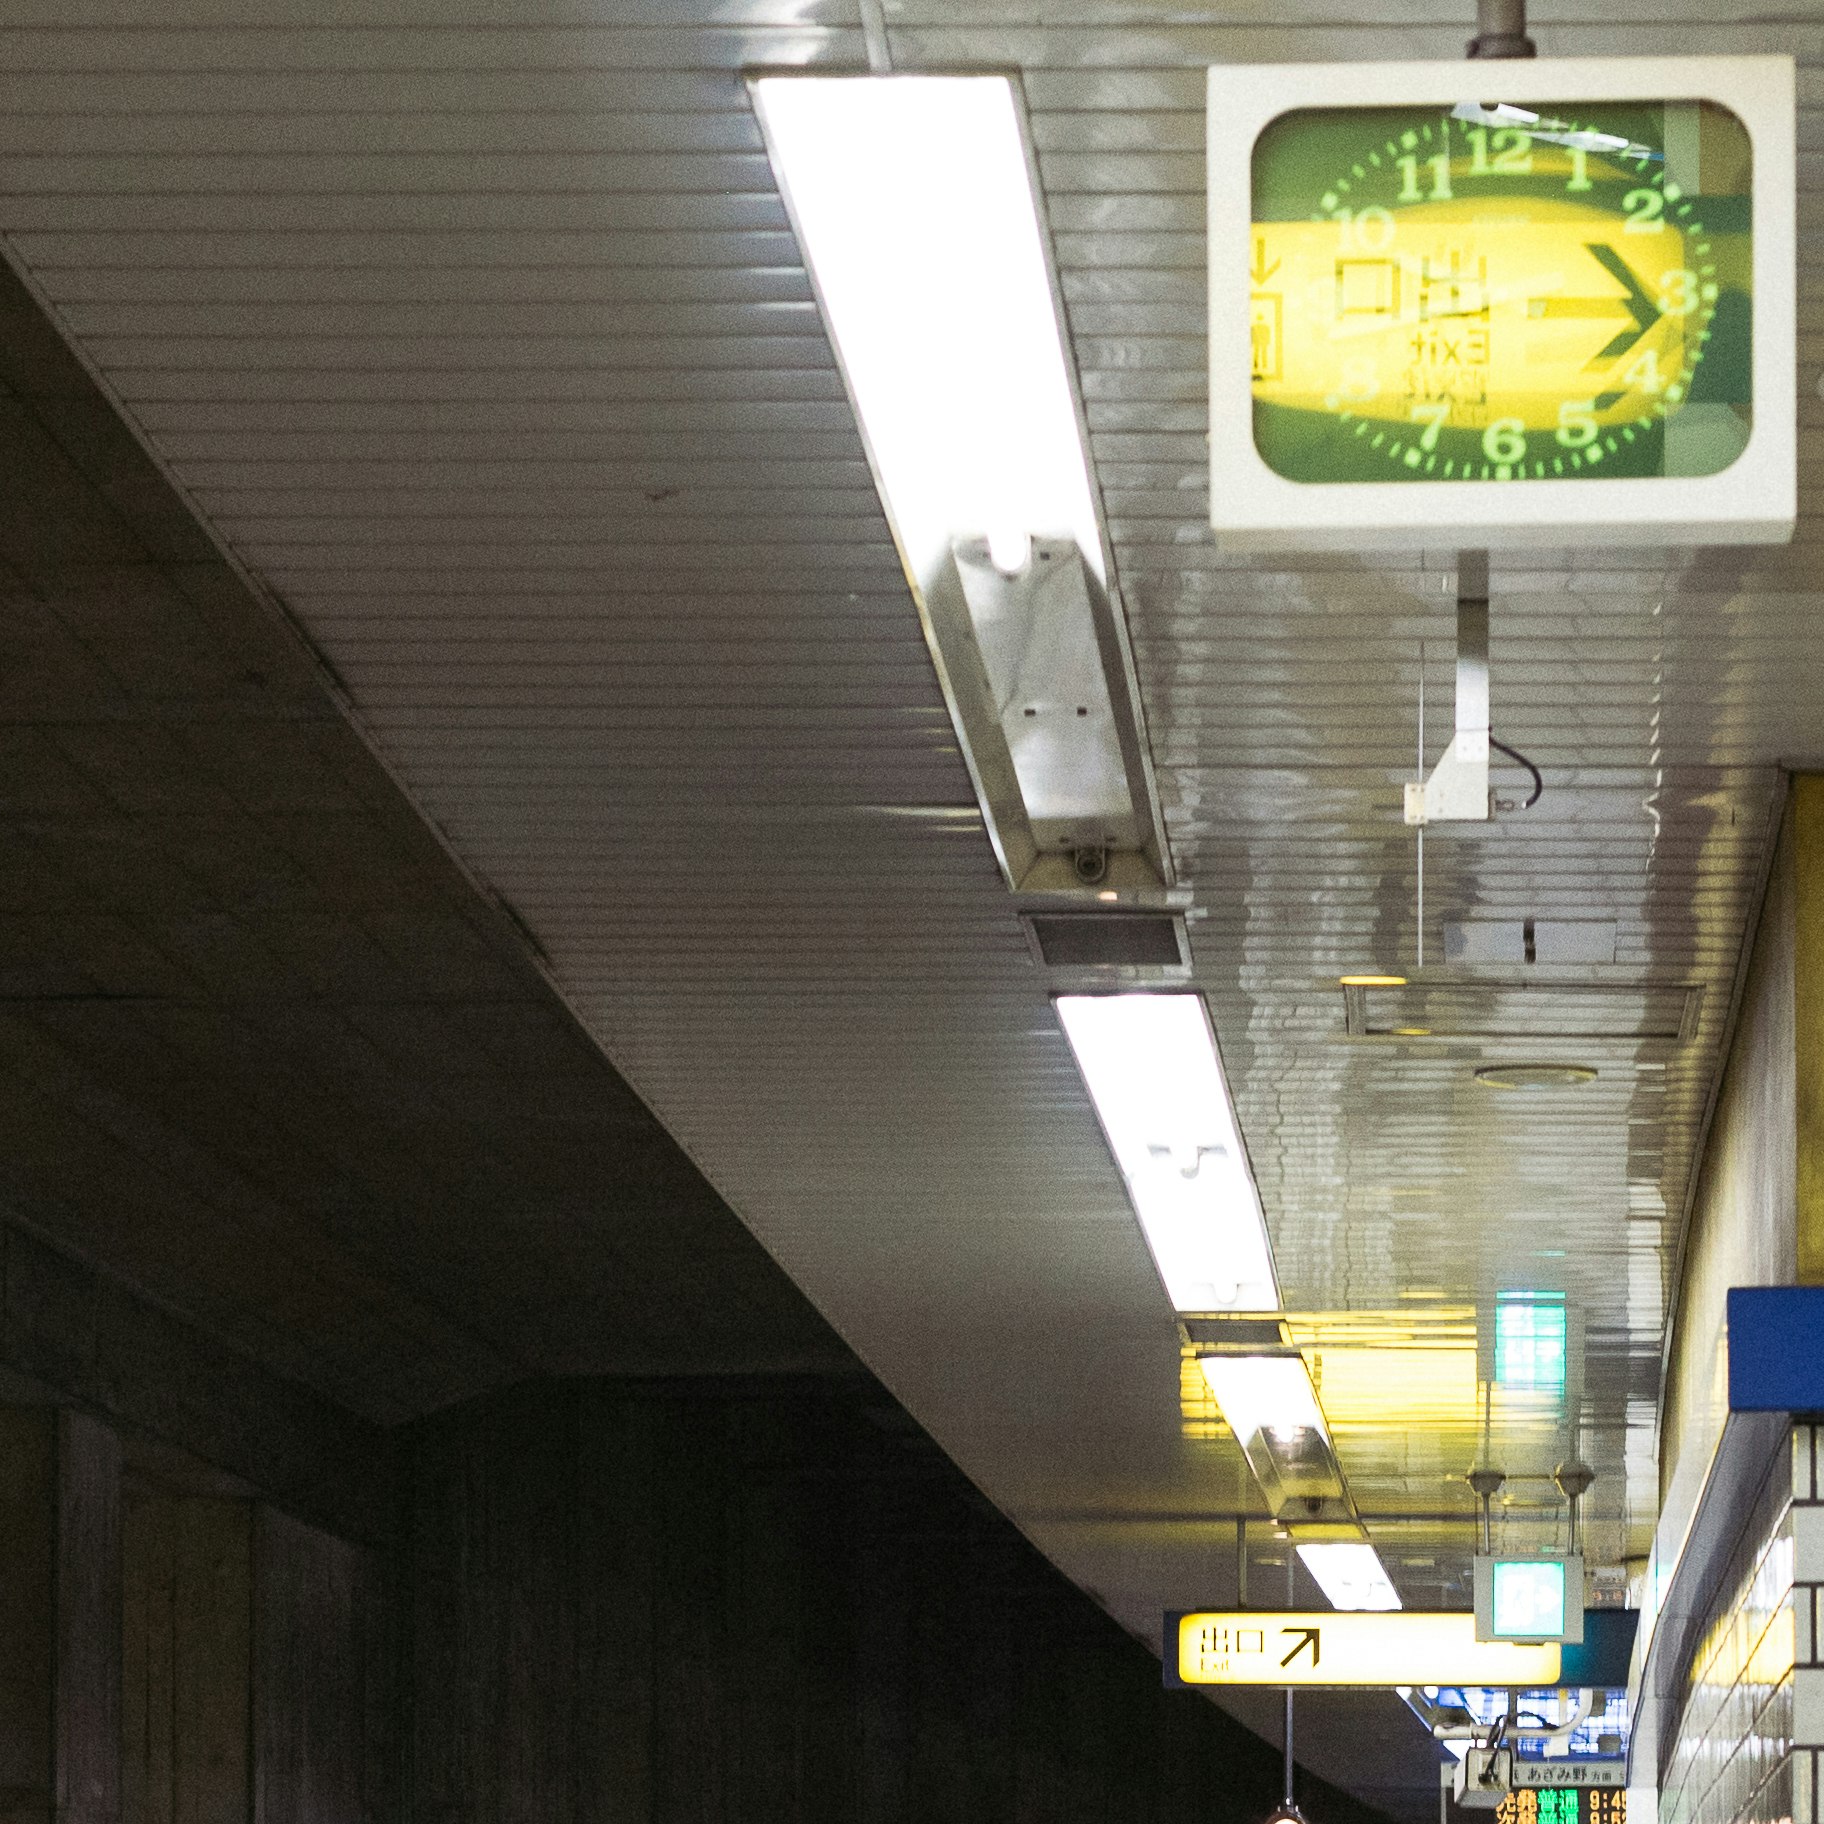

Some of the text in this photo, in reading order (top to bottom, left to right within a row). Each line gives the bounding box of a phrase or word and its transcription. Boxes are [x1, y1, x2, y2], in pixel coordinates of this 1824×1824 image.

[1466, 127, 1532, 175] 12
[1396, 154, 1453, 200] 11
[1332, 205, 1396, 251] 10
[1622, 188, 1665, 234] 2
[1657, 268, 1700, 317] 3
[1622, 349, 1665, 394] 4
[1410, 403, 1451, 451] 7
[1481, 416, 1526, 465] 6
[1555, 400, 1598, 448] 5
[1200, 1627, 1263, 1653] 出口
